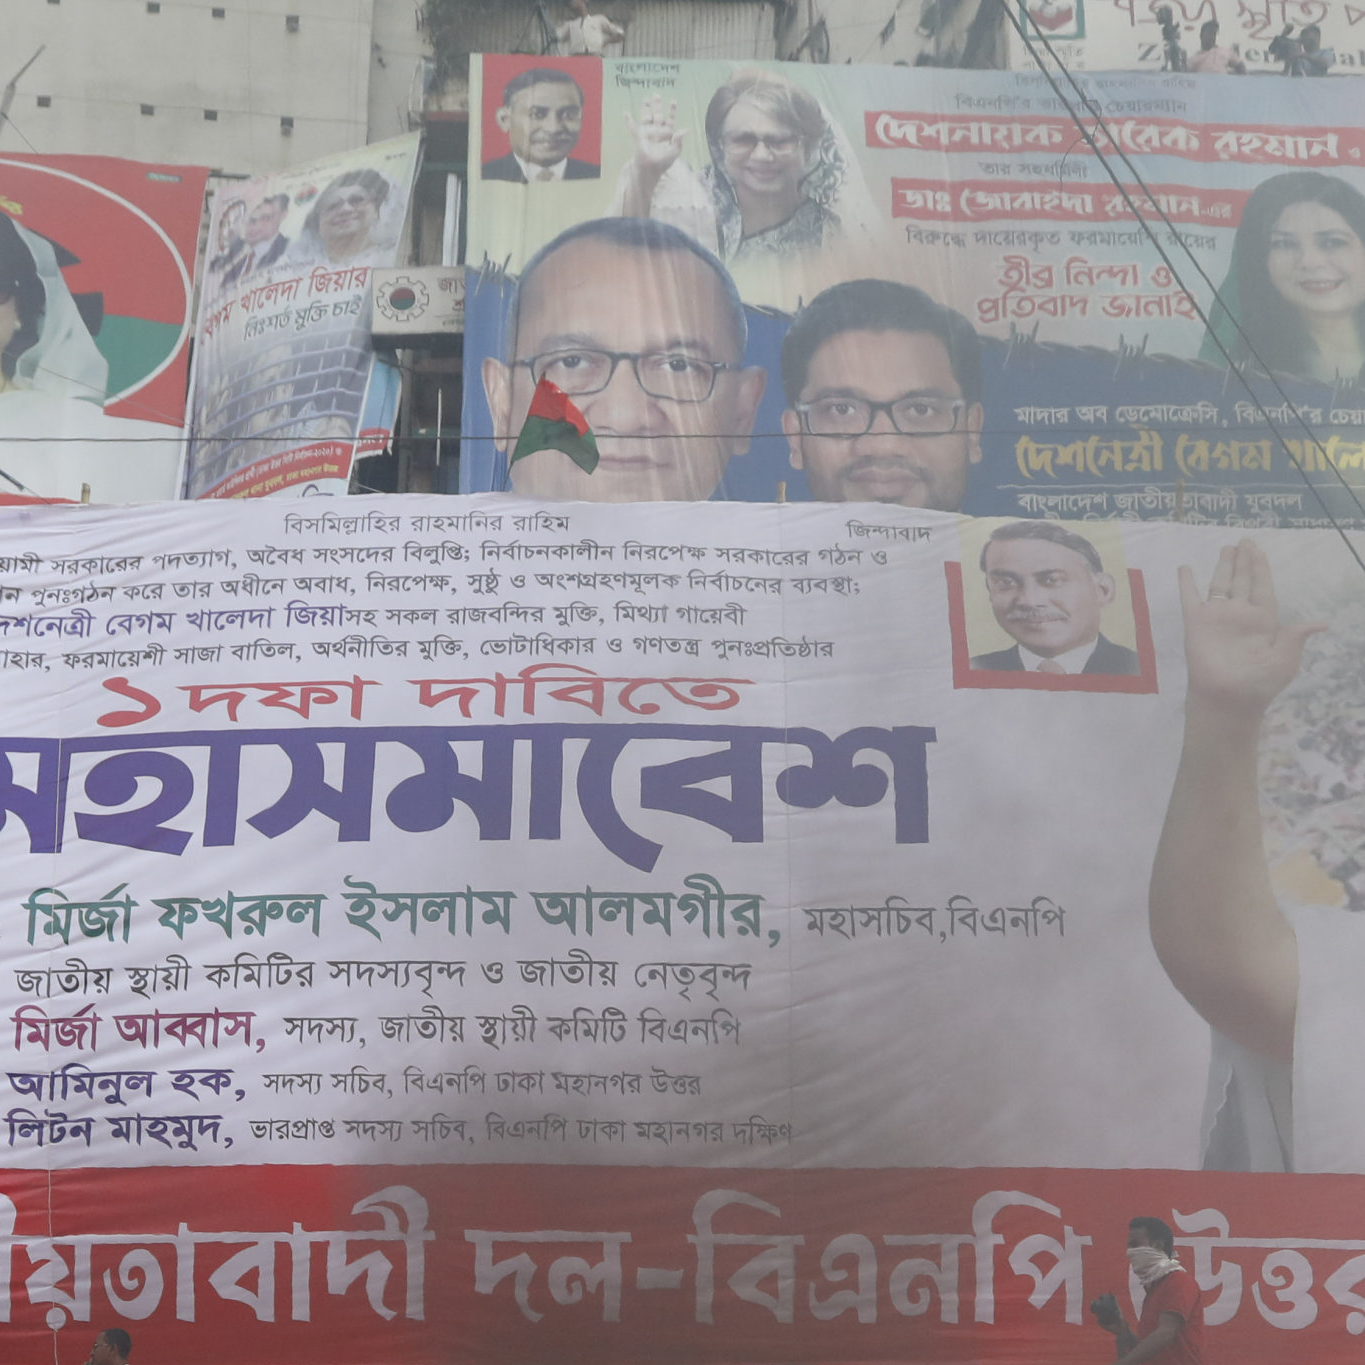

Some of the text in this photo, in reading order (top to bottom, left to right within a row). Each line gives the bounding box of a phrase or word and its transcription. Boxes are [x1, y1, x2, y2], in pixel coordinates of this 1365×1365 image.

[875, 113, 1065, 150] দেশনায়ক
[1210, 130, 1340, 160] রহমান
[960, 188, 1095, 217] জোবাইদা
[905, 223, 1063, 254] বিরুদ্ধে দায়েরকৃত
[240, 276, 304, 315] খালেদা
[308, 265, 373, 299] জিয়ার
[1064, 256, 1176, 288] নিন্দা ও
[294, 299, 331, 332] মুক্তি
[331, 291, 365, 318] চাই
[975, 284, 1200, 324] প্রতিবাদ জানাই
[1013, 401, 1230, 429] মাদার অব ডেমোক্রেসি,
[1013, 422, 1165, 481] দেশনেত্রী
[1174, 432, 1276, 480] বেগম
[283, 510, 572, 536] বিসমিল্লাহির রাহমানির রাহিম
[1017, 490, 1109, 513] বাংলাদেশ
[1244, 493, 1306, 516] যুবদল
[845, 519, 934, 544] জিন্দাবাদ
[50, 554, 145, 576] সরকারের
[246, 544, 307, 566] অবৈধ
[313, 545, 396, 566] সংসদের
[479, 538, 616, 564] নির্বাচনকালীন
[622, 539, 708, 564] নিরপেক্ষ
[714, 546, 811, 568] সরকারের
[817, 543, 864, 566] গঠন
[871, 549, 890, 567] ও
[122, 582, 167, 602] করে
[170, 580, 215, 600] তার
[220, 571, 288, 598] অধীনে
[509, 575, 527, 591] ও
[535, 570, 682, 597] অংশগ্রহণমূলক
[687, 569, 784, 595] নির্বাচনের
[105, 611, 178, 636] বেগম
[185, 605, 277, 632] খালেদা
[385, 607, 441, 626] সকল
[446, 600, 546, 626] রাজবন্দির
[611, 600, 671, 625] মিথ্যা
[675, 601, 749, 626] গায়েবী
[61, 641, 168, 671] ফরমায়েশী
[173, 643, 224, 665] সাজা
[311, 633, 411, 661] অর্থনীতির
[479, 630, 597, 657] ভোটাধিকার
[605, 636, 624, 656] ও
[632, 635, 704, 659] গণতন্ত্র
[417, 661, 758, 724] দাবিতে
[21, 871, 783, 950] মির্জা ফখরুল ইসলাম আলমগীর,
[12, 947, 755, 1003] জাতীয় স্থায়ী কমিটির সদস্যবৃন্দ ও জাতীয় নেতৃবৃন্দ
[11, 1002, 743, 1056] মির্জা আব্বাস, সদস্য, জাতীয় স্থায়ী কমিটি বিএনপি
[4, 1060, 703, 1112] আমিনুল হক, সদস্য বিএনপি ঢাকা মহানগর উত্তর
[1, 1106, 726, 1153] লিটন মাহমুদ, ভারপ্রাপ্ত সদস্য বিএনপি ঢাকা মহানগর
